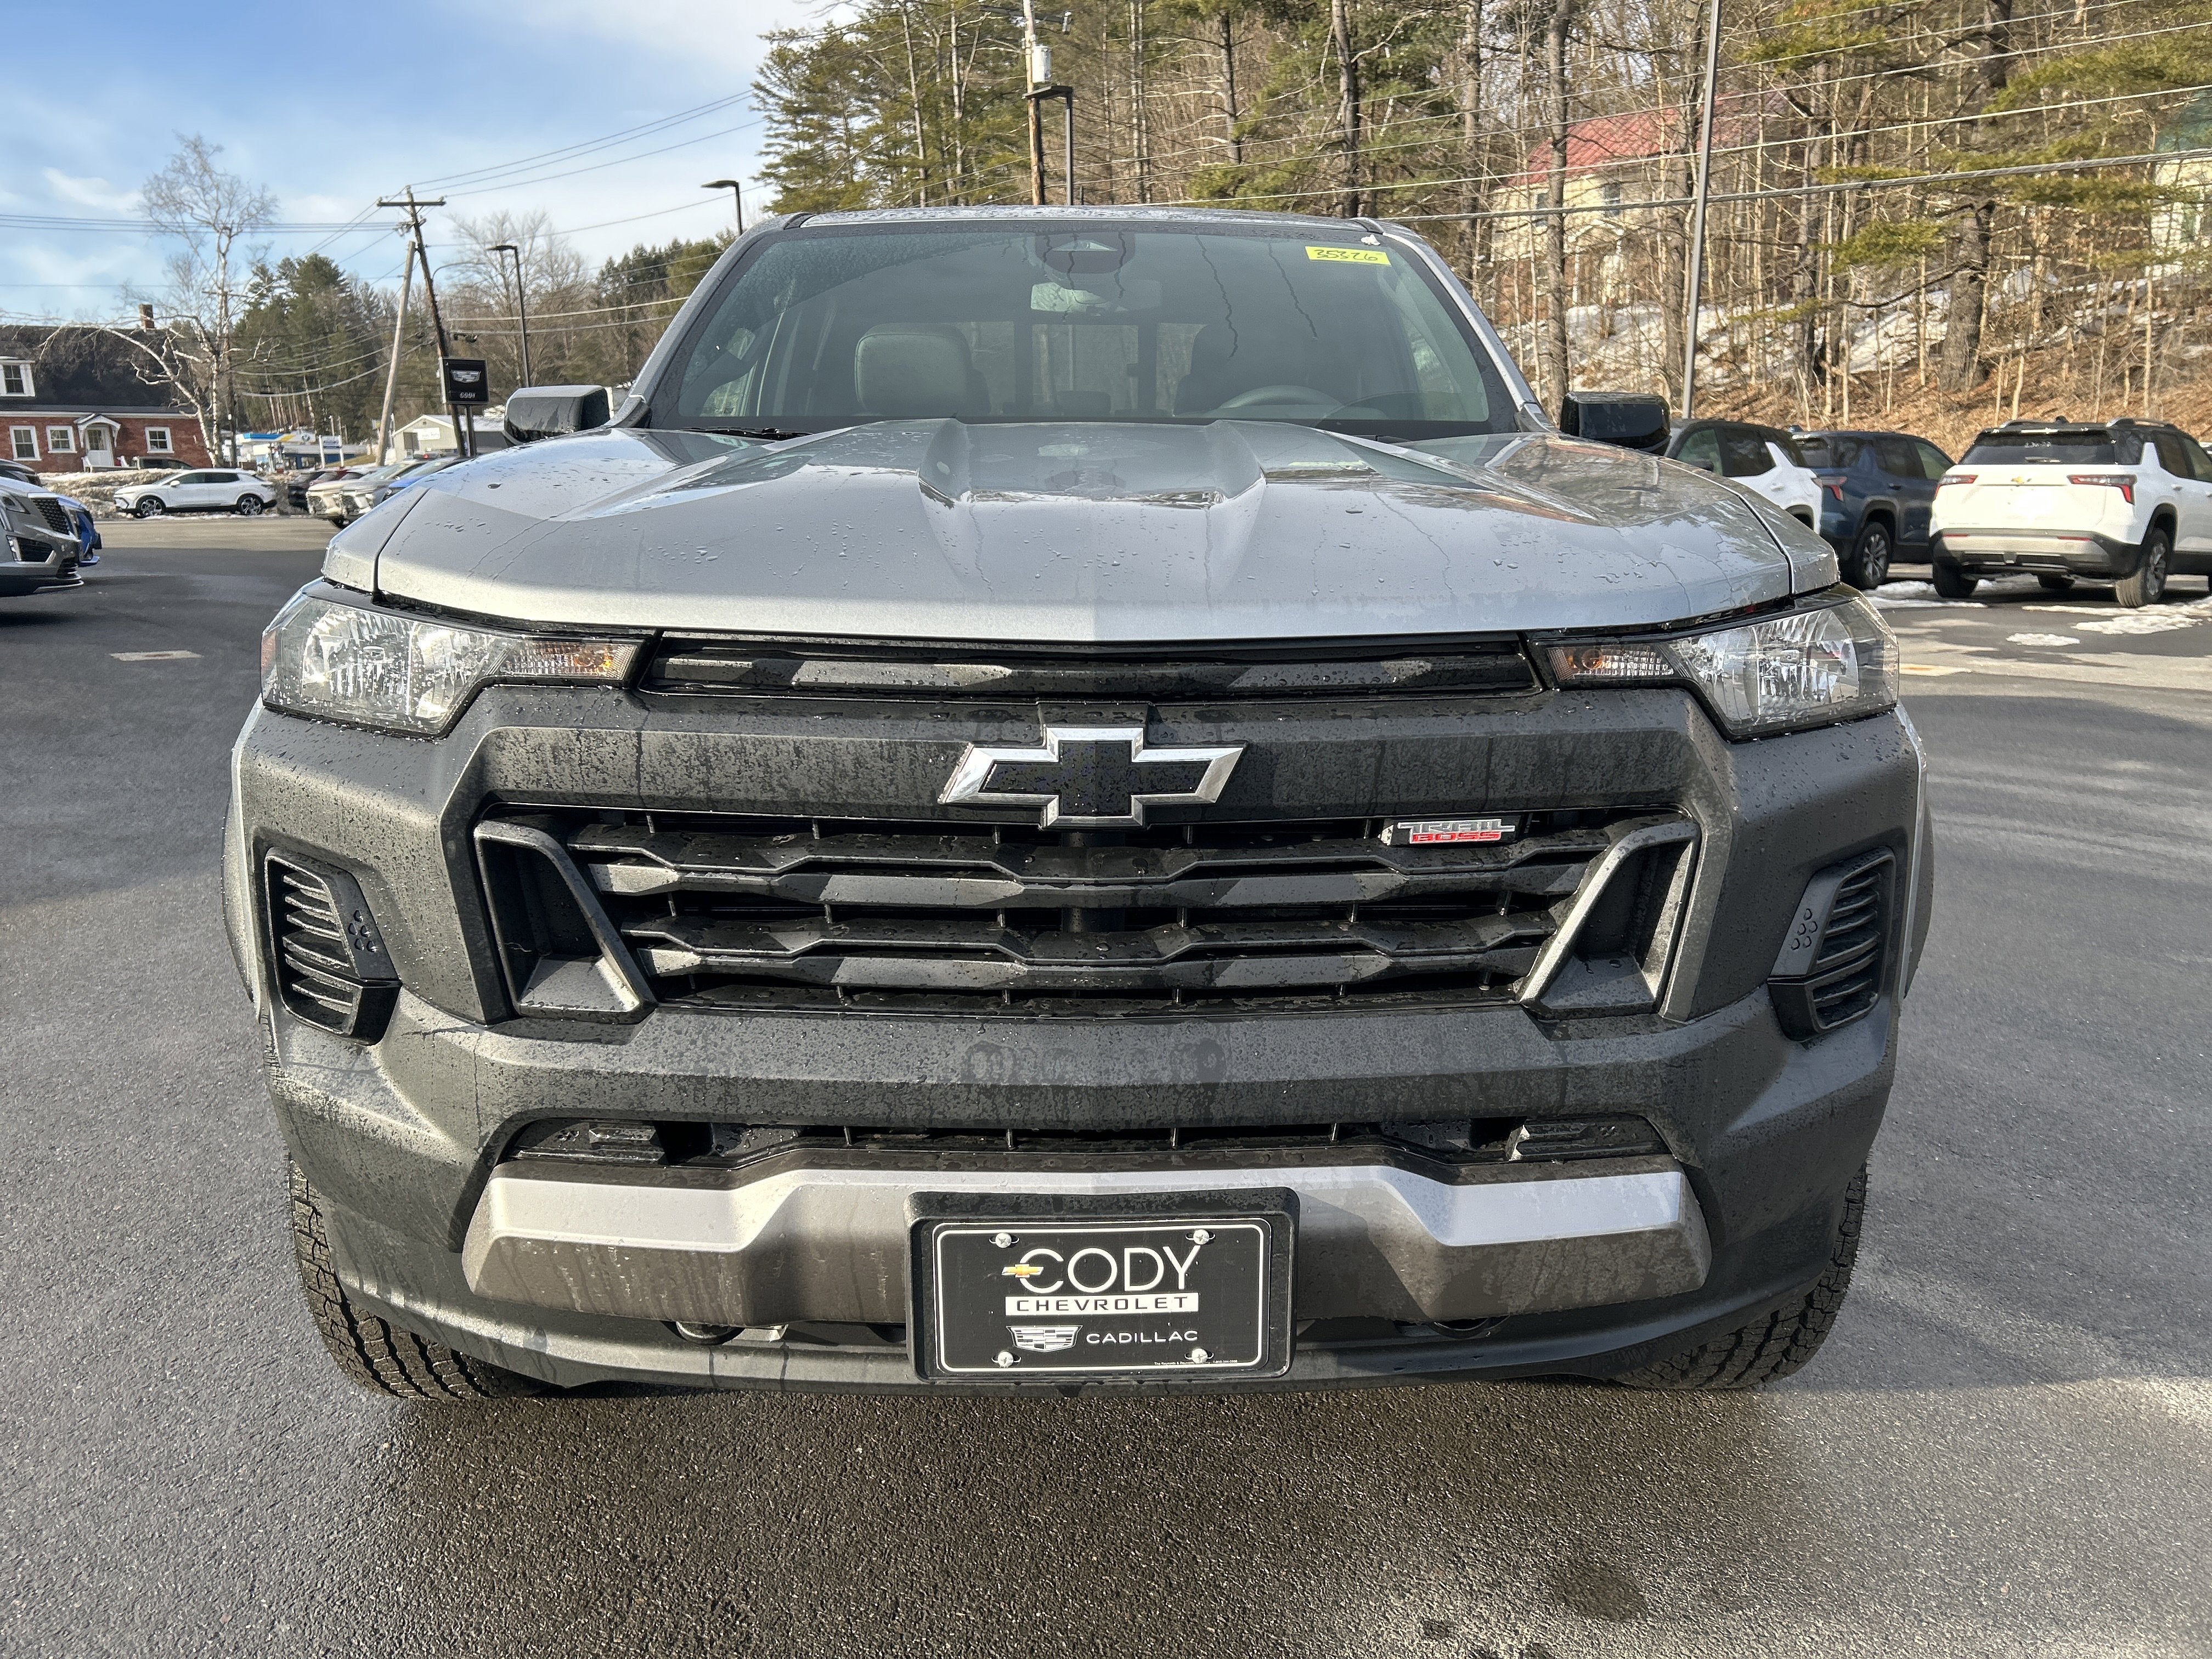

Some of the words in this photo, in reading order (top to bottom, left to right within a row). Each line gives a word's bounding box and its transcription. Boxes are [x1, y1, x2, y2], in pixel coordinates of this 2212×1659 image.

[1314, 249, 1378, 261] 35326
[1397, 819, 1516, 834] TRAIL
[1411, 831, 1502, 844] BOSS
[1019, 1245, 1201, 1294] CODY
[1017, 1296, 1189, 1312] CHEVROLET
[1086, 1330, 1198, 1344] CADILLAC
